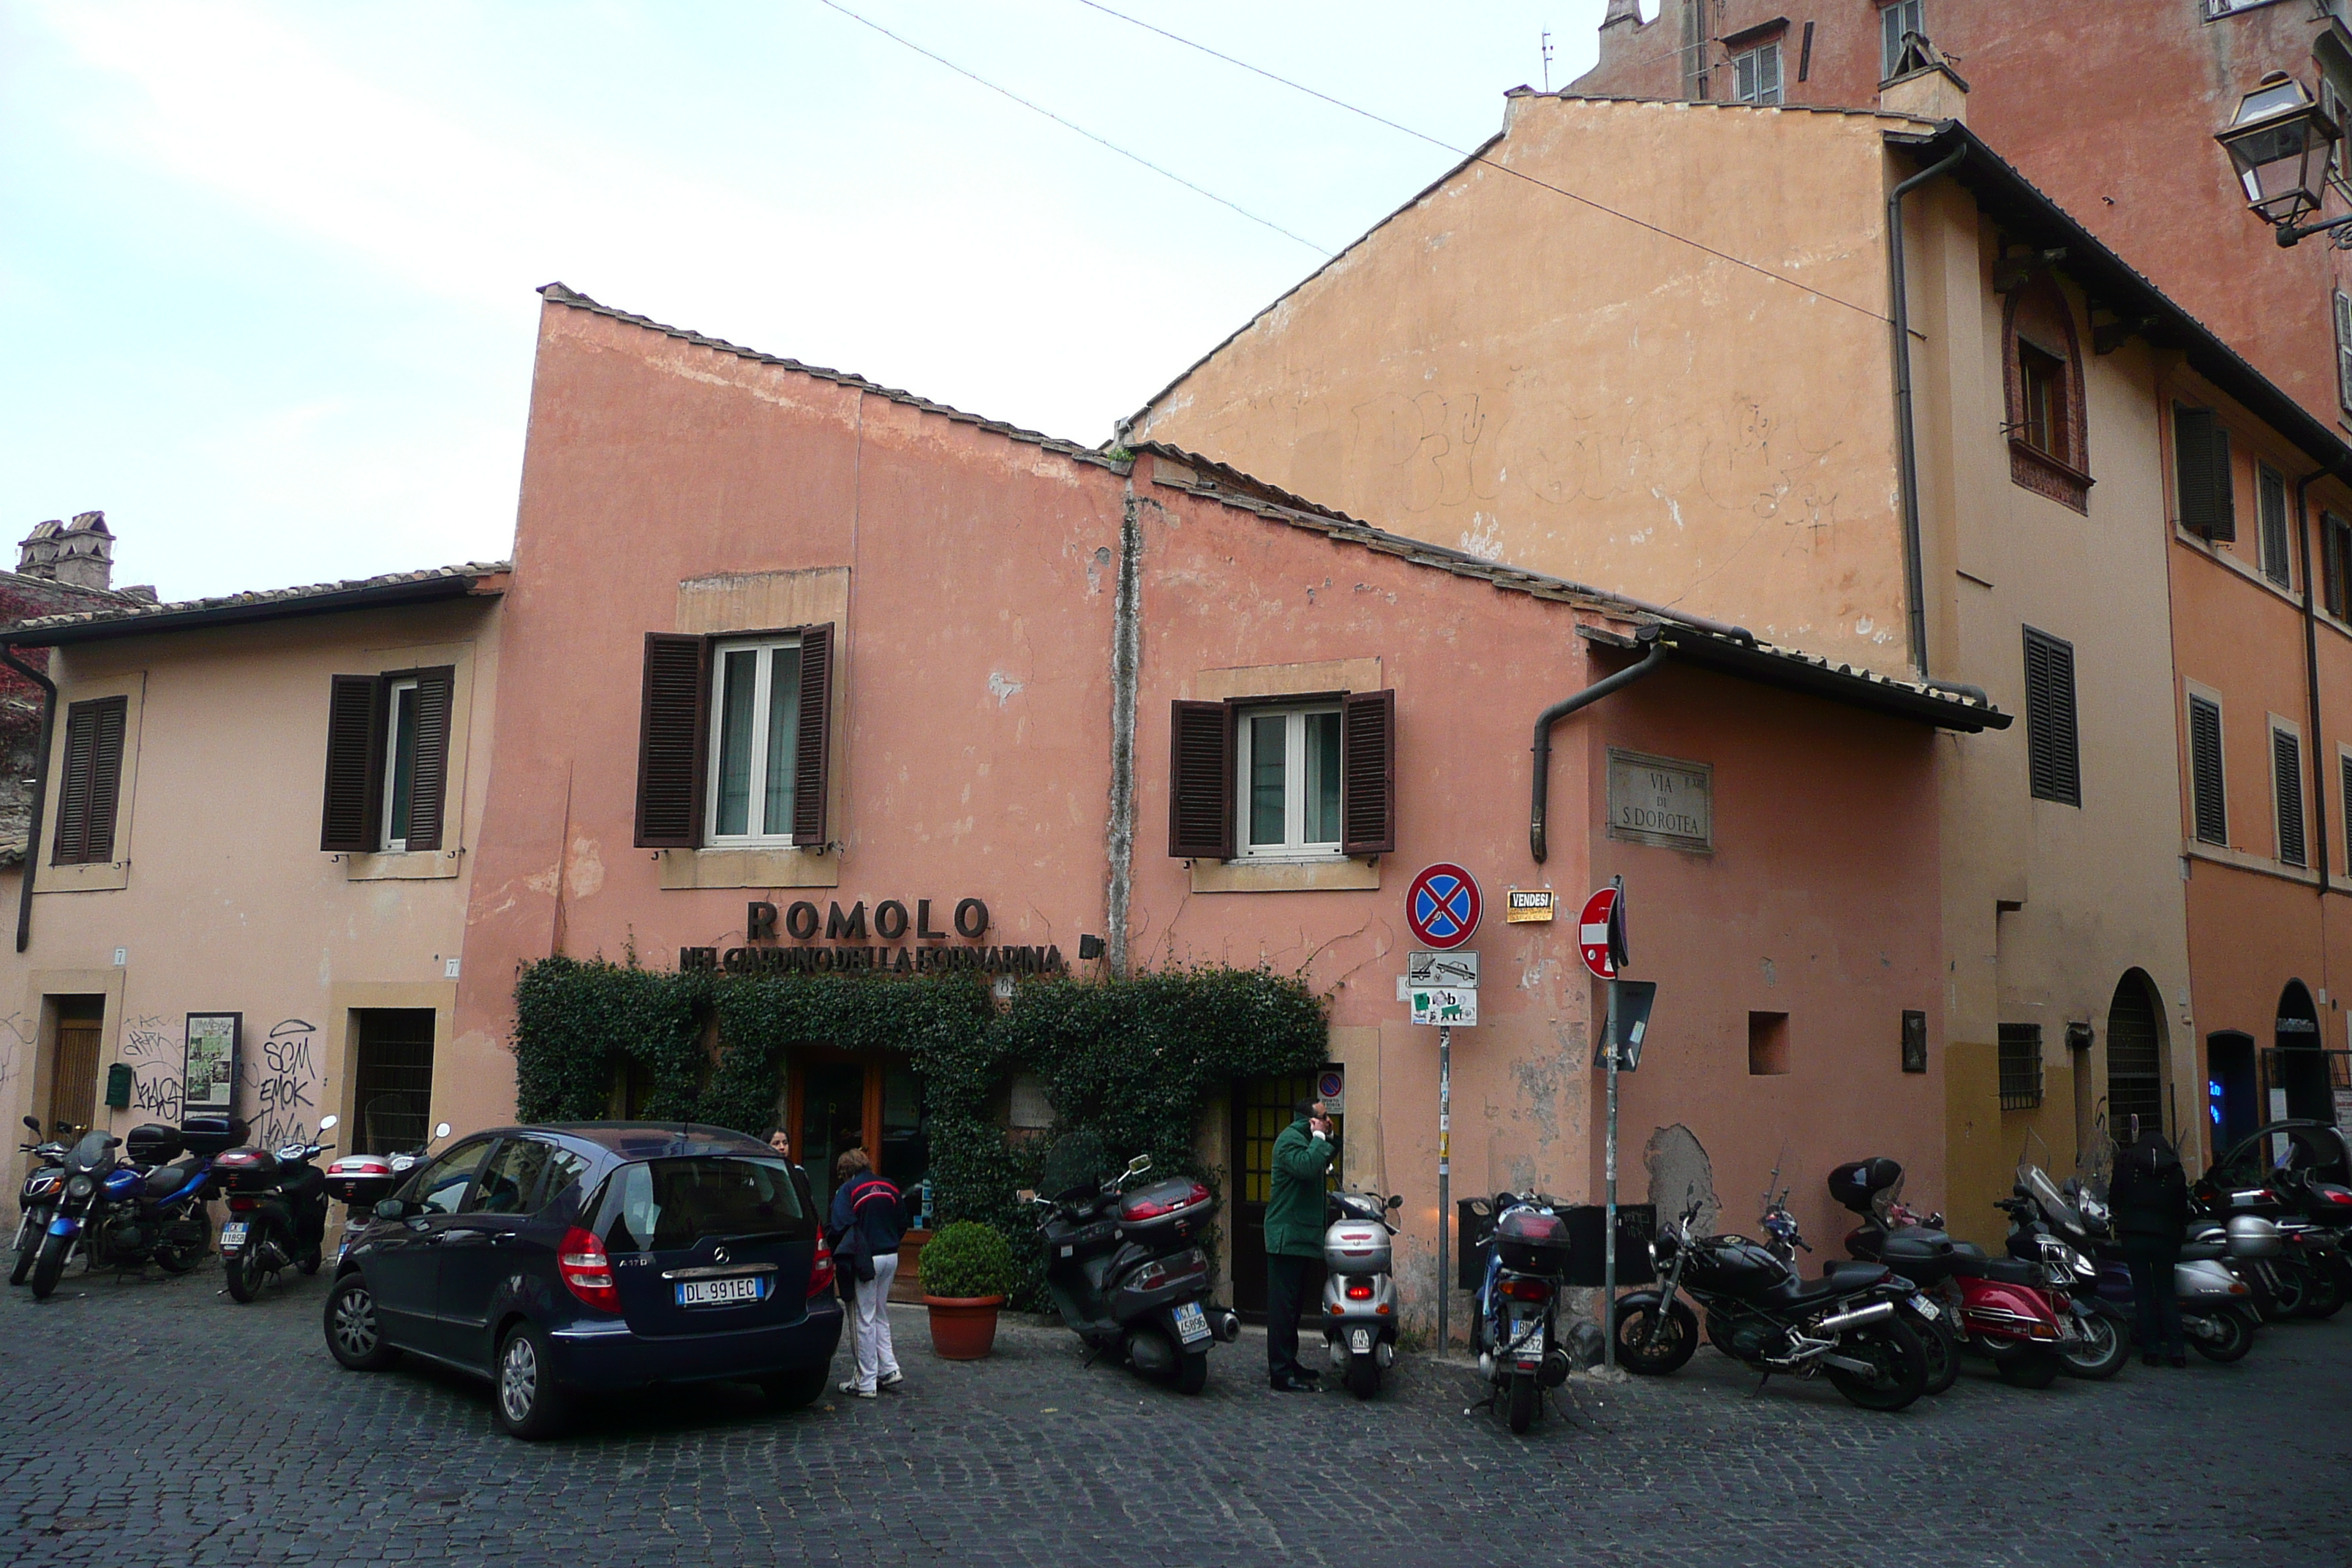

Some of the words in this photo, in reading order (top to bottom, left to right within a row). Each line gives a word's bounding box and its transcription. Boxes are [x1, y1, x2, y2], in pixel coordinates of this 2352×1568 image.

[1651, 773, 1673, 794] VIA
[1656, 796, 1667, 808] DI
[1635, 808, 1699, 834] DOROTEA
[1512, 893, 1549, 907] VENDESI
[747, 898, 990, 941] ROMOLO
[118, 950, 124, 963] 7
[679, 946, 724, 973] NEL
[723, 946, 834, 974] GIARDINO
[835, 946, 913, 973] DELLA
[916, 945, 1062, 974] FORNARINA
[263, 1037, 316, 1080] SCM
[260, 1074, 314, 1110] EMOK
[686, 1284, 704, 1302] DL
[709, 1280, 755, 1300] 991EC
[1179, 1304, 1191, 1319] CY
